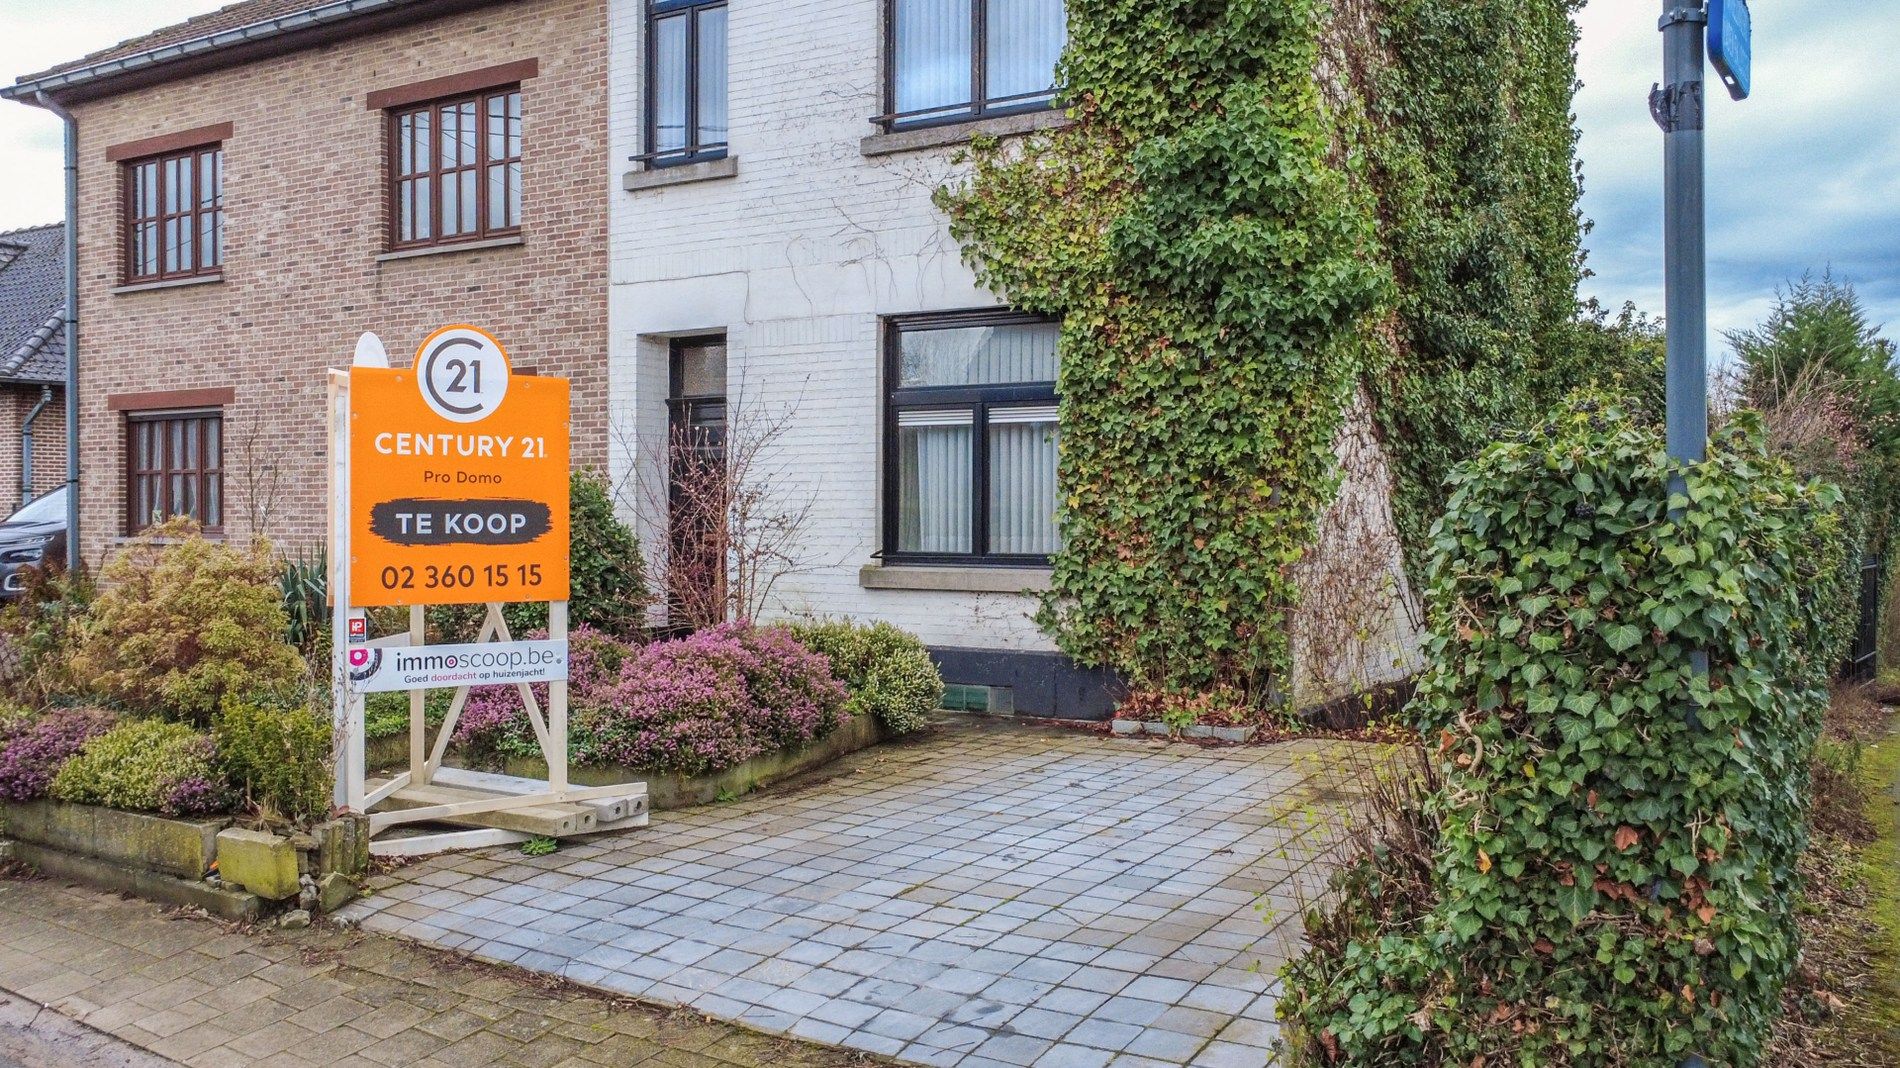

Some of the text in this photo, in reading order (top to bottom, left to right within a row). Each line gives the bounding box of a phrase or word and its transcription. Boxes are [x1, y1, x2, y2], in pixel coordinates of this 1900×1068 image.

[445, 358, 481, 394] 21
[374, 432, 544, 458] CENTURY 21
[423, 470, 503, 484] Pro Domo
[395, 513, 527, 534] TE KOOP
[381, 563, 542, 589] 02 360 15 15
[404, 667, 546, 684] Goed doordacht op huizenjacht!
